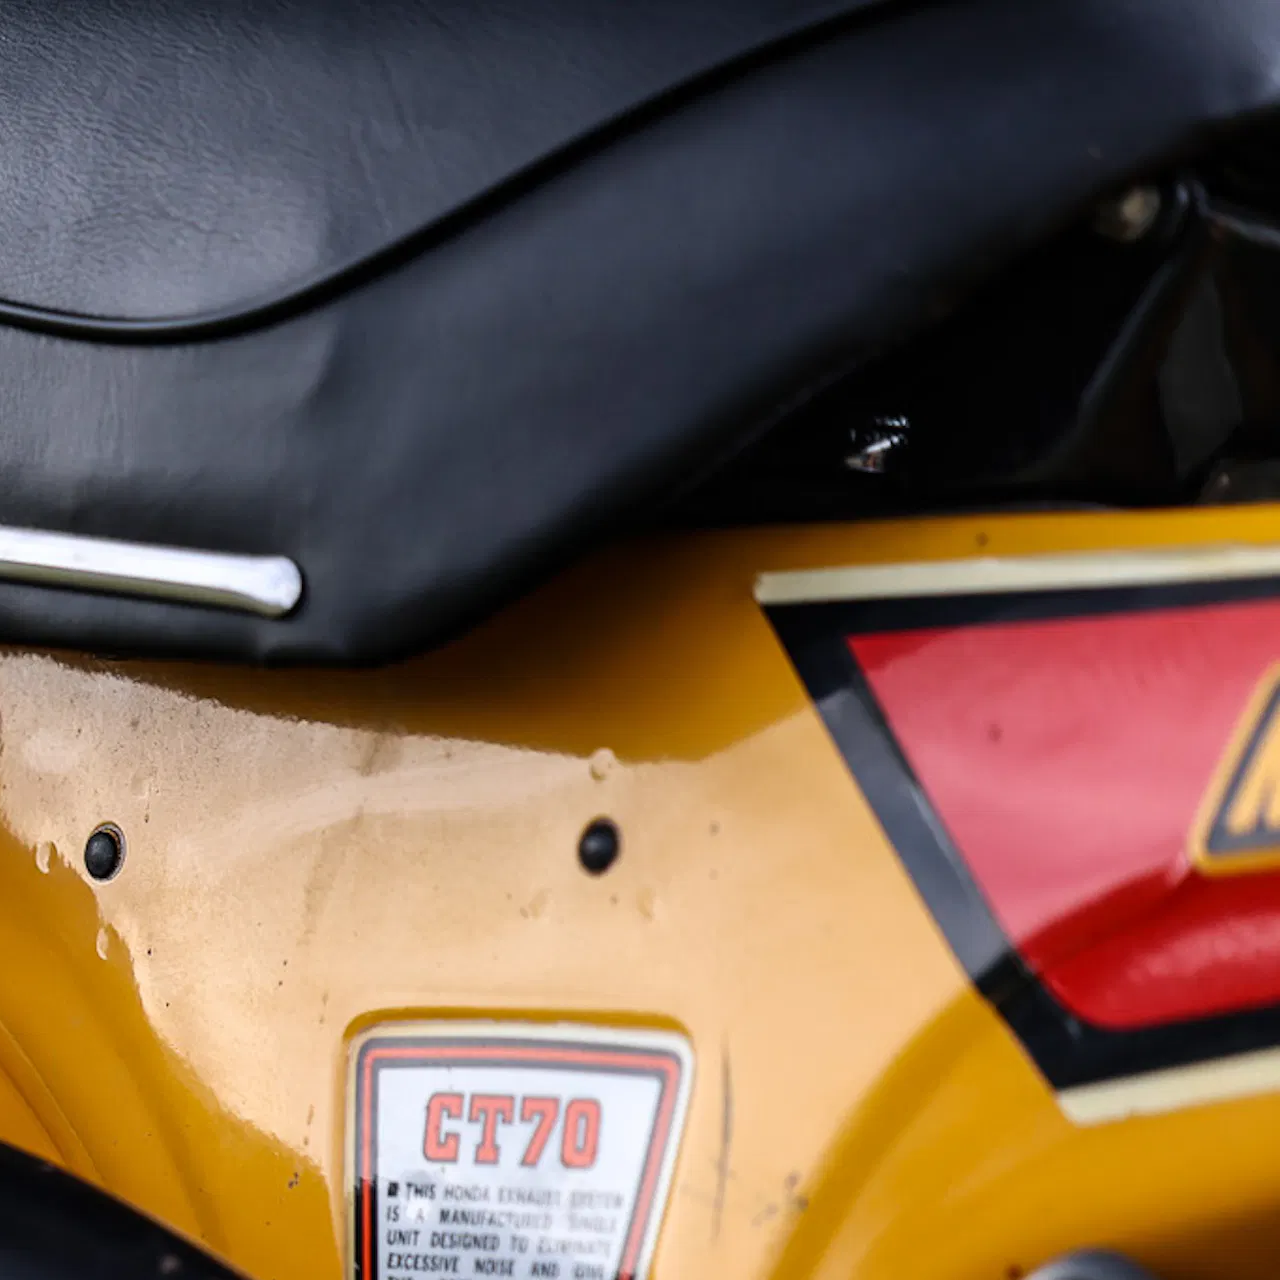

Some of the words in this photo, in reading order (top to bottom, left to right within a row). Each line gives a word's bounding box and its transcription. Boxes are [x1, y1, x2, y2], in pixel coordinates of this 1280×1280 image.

[424, 1092, 602, 1169] CT70
[406, 1182, 436, 1200] THIS
[387, 1205, 400, 1223] IS
[386, 1228, 420, 1247] UNIT
[429, 1230, 501, 1251] DESIGNED
[510, 1233, 529, 1254] TO
[386, 1251, 459, 1274] EXCESSIVE
[473, 1256, 515, 1277] NOISE
[531, 1260, 560, 1280] AND
